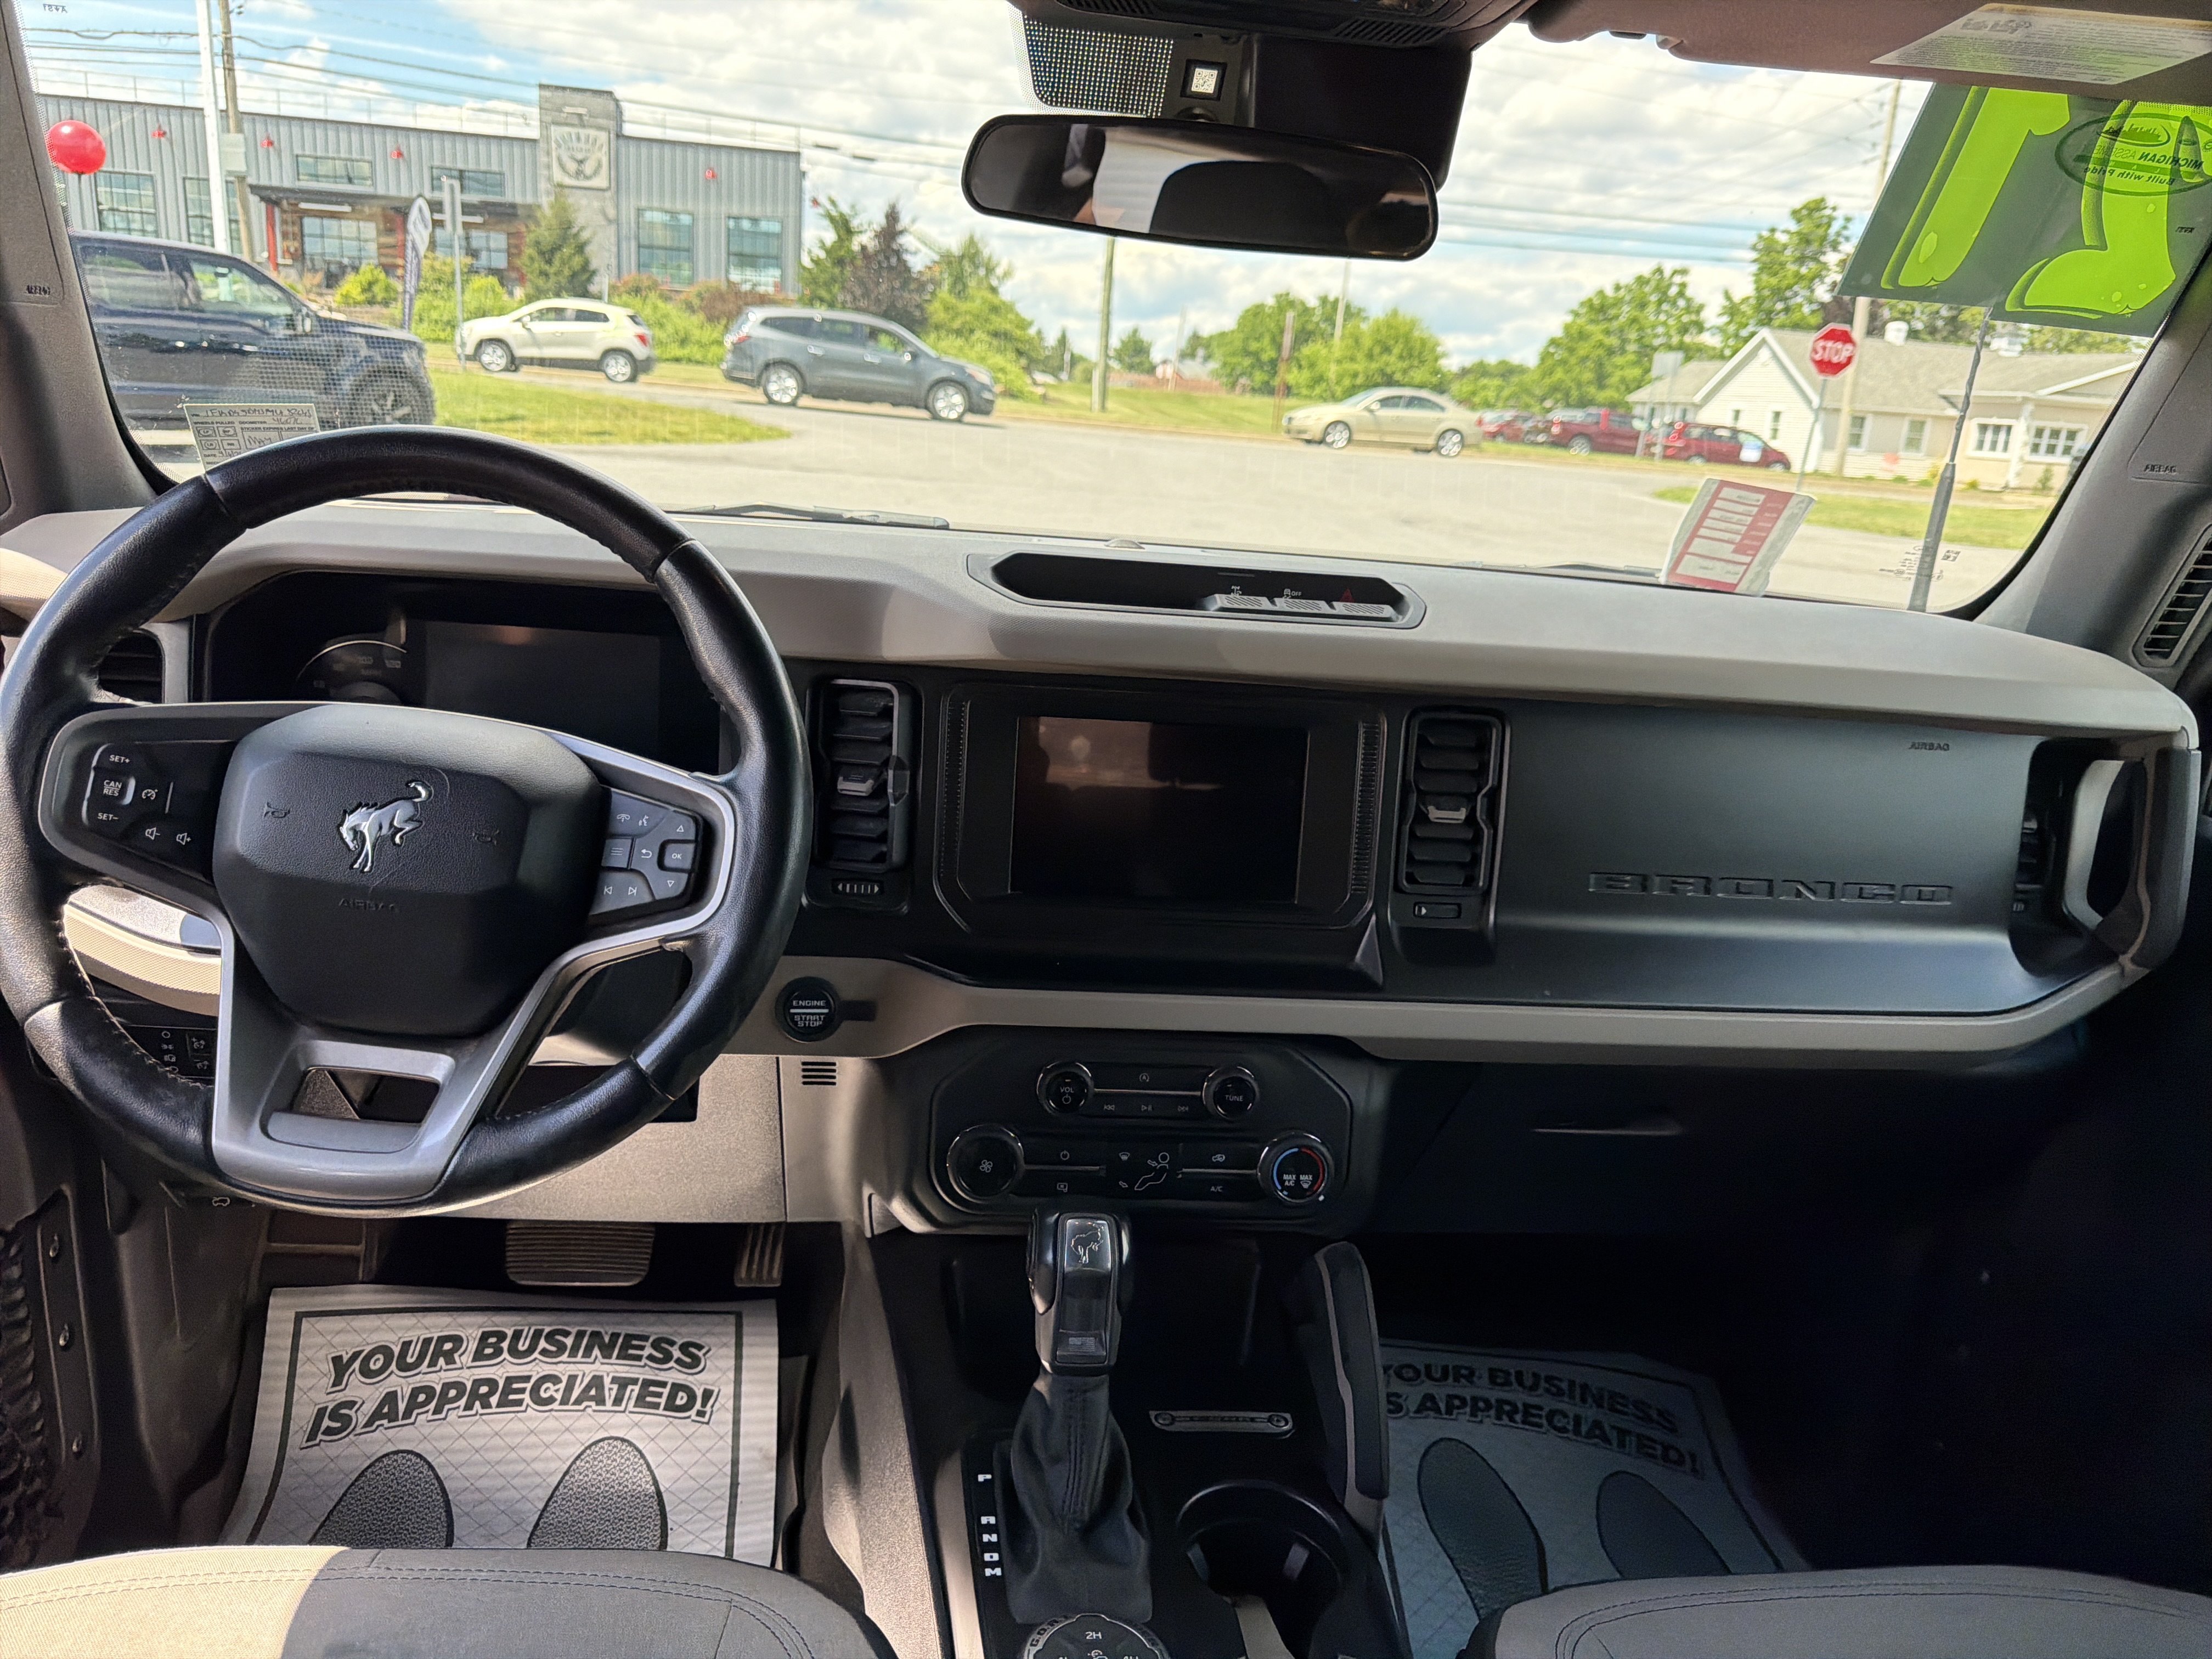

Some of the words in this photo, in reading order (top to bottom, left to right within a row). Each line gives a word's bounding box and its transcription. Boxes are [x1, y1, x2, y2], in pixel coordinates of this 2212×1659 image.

[1812, 340, 1854, 364] STOP
[1908, 742, 1950, 751] AIRBAG
[110, 754, 130, 763] SET+
[104, 780, 122, 789] CAN
[103, 788, 120, 797] RES
[1588, 872, 1953, 905] BRONCO
[330, 1334, 464, 1389] YOUR
[471, 1327, 707, 1370] BUSINESS
[1487, 1367, 1679, 1434] BUSINESS
[304, 1400, 359, 1444] IS
[360, 1373, 716, 1429] APPRECIATED!
[1386, 1391, 1407, 1415] S
[1413, 1392, 1700, 1475] APPRECIATED!
[983, 1533, 997, 1542] N
[984, 1553, 1000, 1561] D
[985, 1567, 1002, 1577] M
[1085, 1631, 1102, 1640] 2H
